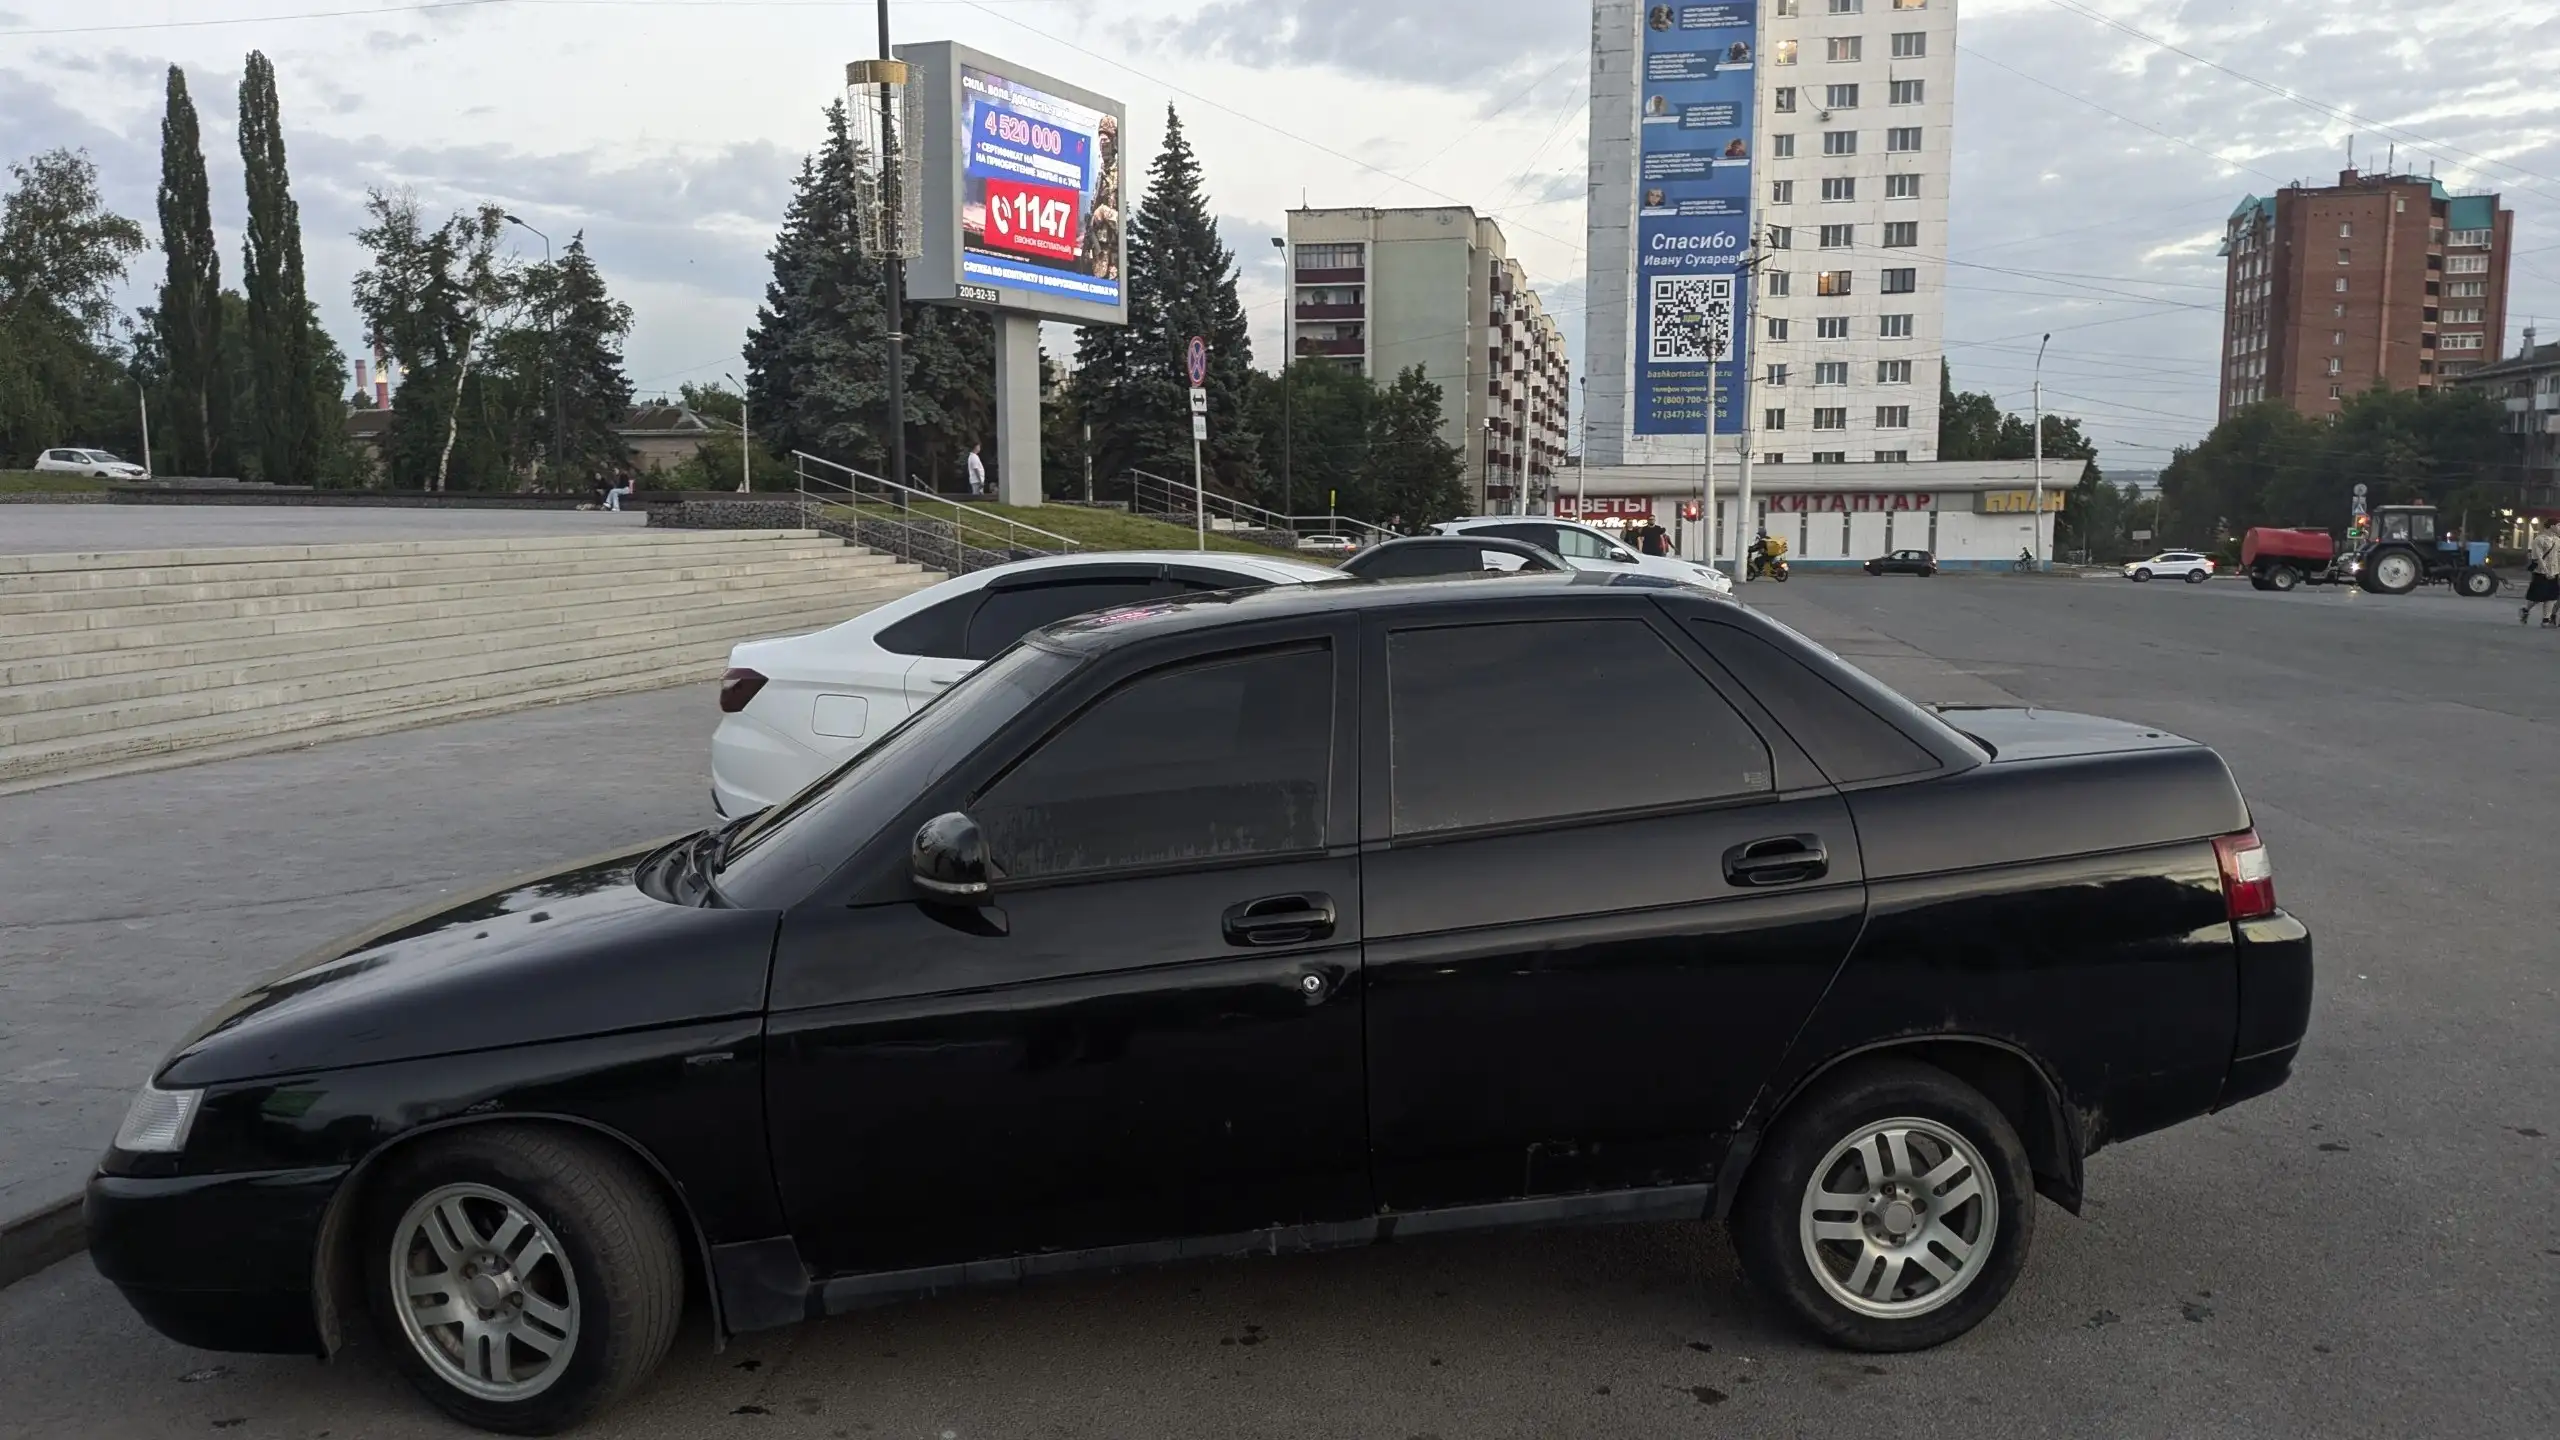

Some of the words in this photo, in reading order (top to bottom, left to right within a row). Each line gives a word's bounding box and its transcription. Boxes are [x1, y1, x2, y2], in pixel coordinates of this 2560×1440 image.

[985, 111, 997, 136] 4
[1000, 114, 1029, 146] 520
[1031, 124, 1061, 155] 000
[976, 152, 986, 163] НА
[986, 155, 1037, 177] ПРИОБРЕТЕНИЕ
[1014, 192, 1071, 239] 1147
[1652, 231, 1736, 250] Спасибо
[1644, 254, 1682, 268] Ивану
[1685, 253, 1741, 267] Сухареву
[960, 286, 996, 301] 200-92-35
[1663, 396, 1684, 405] (800)
[1560, 498, 1647, 515] ЦВЕТЫ
[1770, 493, 1931, 512] КИТАПТАР
